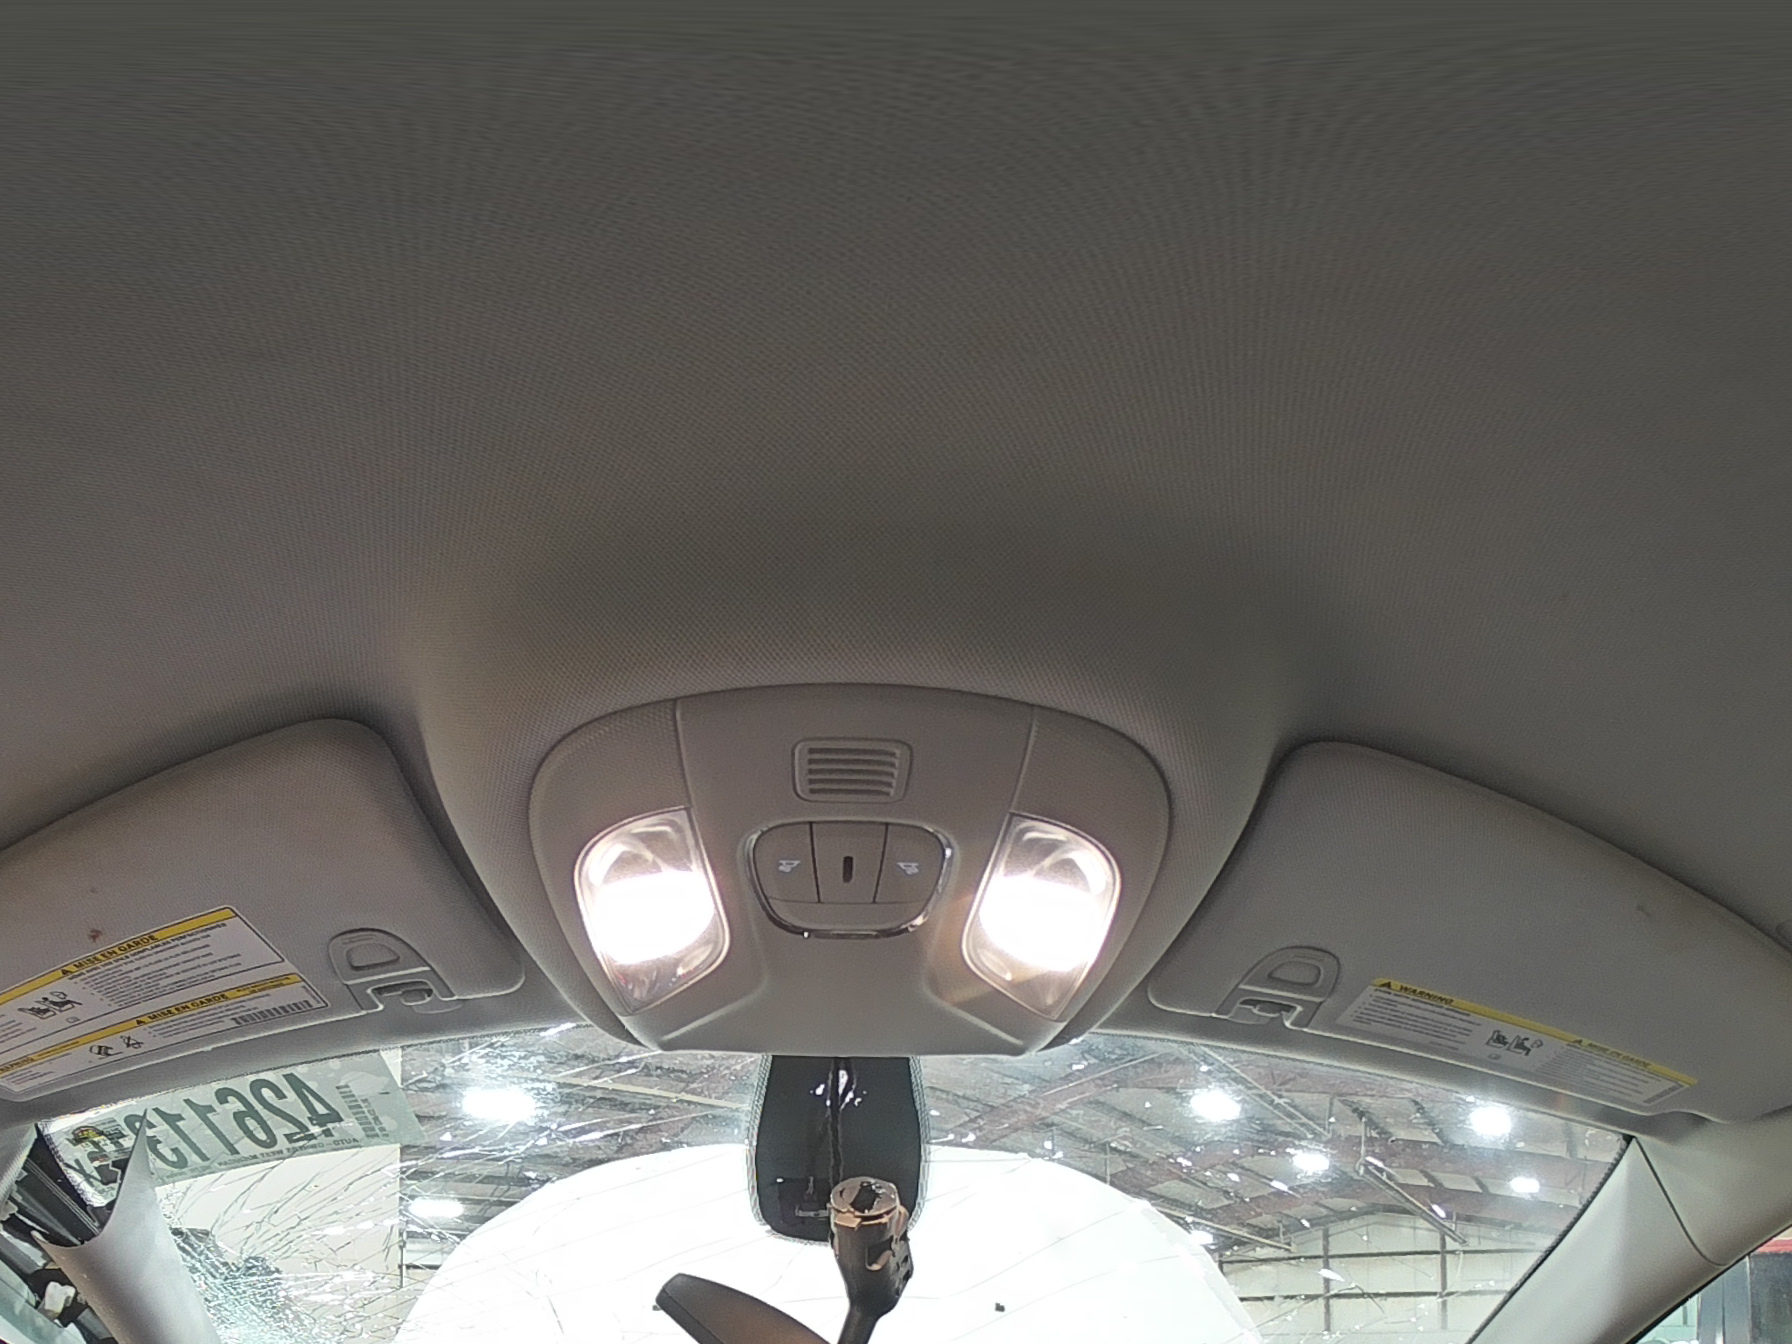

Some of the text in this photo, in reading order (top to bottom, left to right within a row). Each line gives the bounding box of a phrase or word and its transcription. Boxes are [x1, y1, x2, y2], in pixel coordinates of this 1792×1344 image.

[73, 934, 158, 970] MISE EN GARDE
[148, 993, 229, 1021] MISE EN GARDE
[1399, 985, 1454, 1005] WARNING
